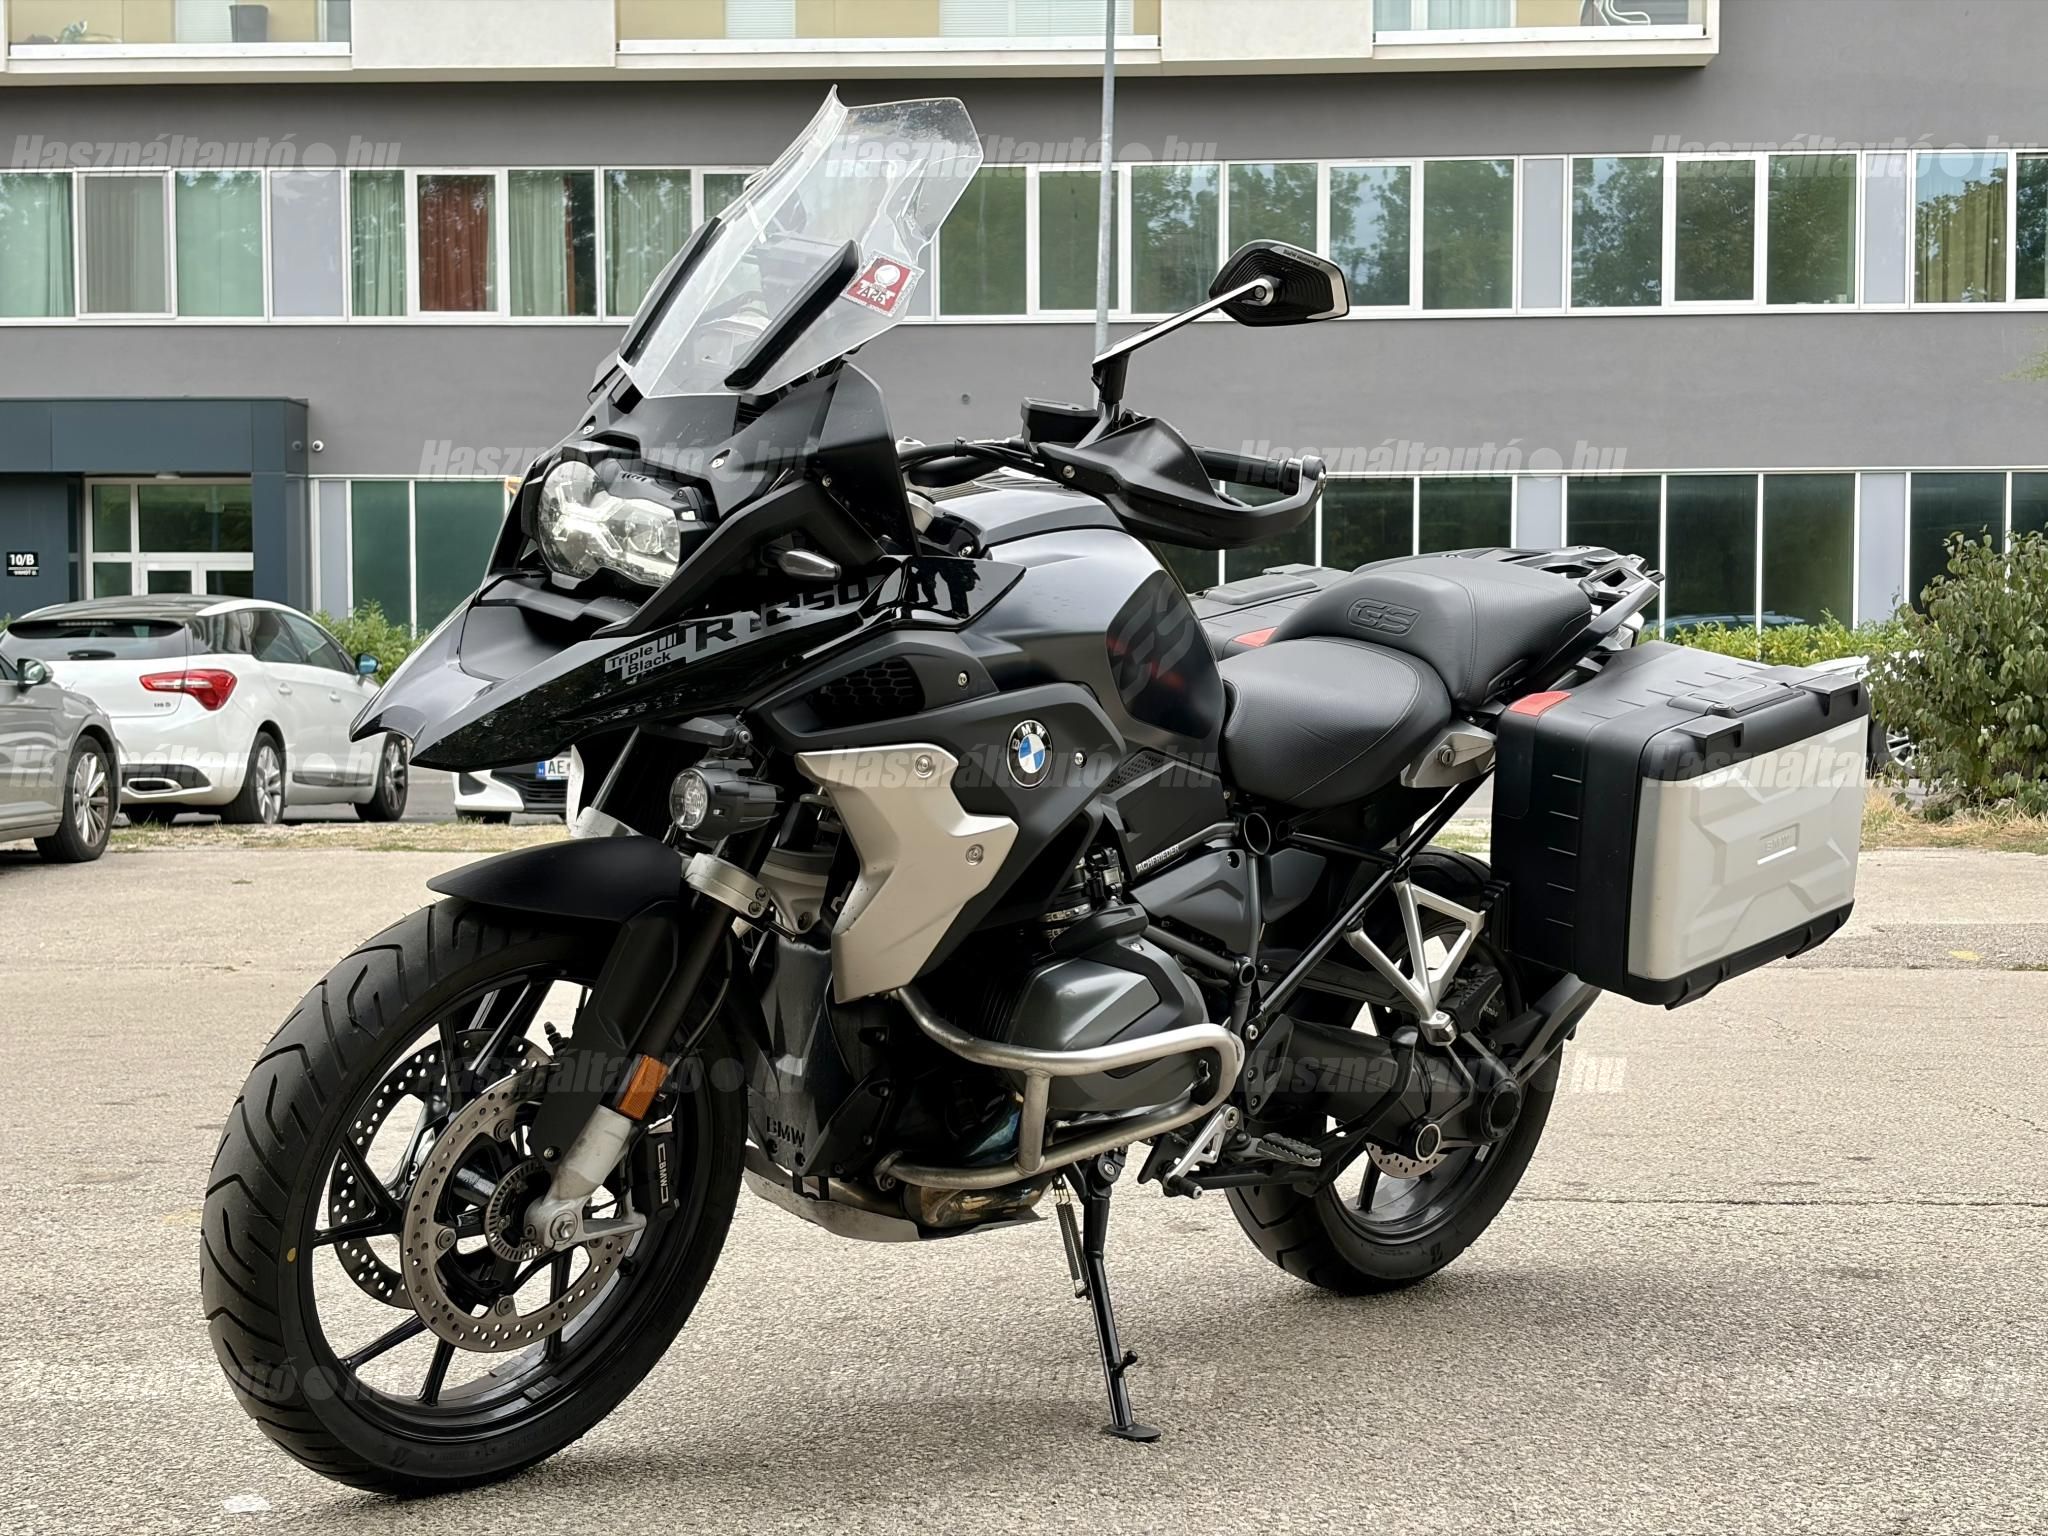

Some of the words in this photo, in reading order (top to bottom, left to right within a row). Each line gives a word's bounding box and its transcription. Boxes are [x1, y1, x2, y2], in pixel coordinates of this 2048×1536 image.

[10, 554, 35, 566] 10/B
[1350, 600, 1417, 635] GS
[608, 646, 653, 668] Triple
[628, 652, 671, 675] Black
[1010, 723, 1047, 752] BMW
[766, 1115, 806, 1148] BMW
